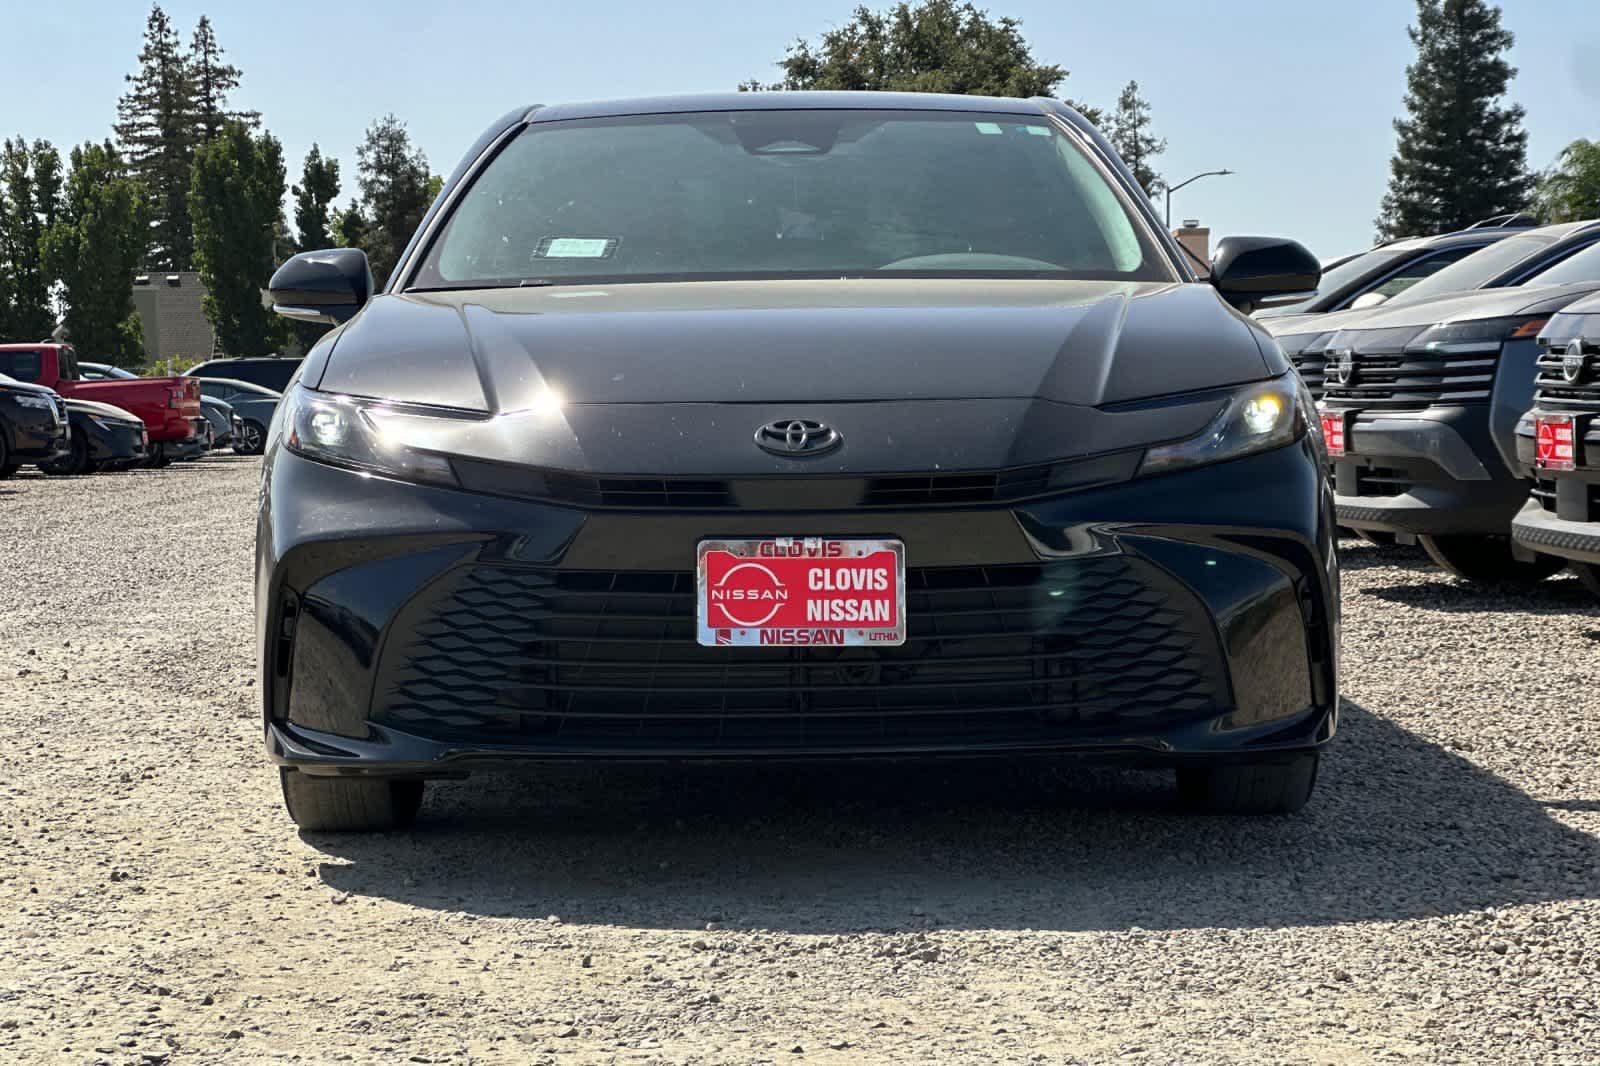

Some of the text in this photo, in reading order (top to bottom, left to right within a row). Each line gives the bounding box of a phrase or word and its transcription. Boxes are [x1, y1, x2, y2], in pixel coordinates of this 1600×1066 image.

[760, 541, 841, 557] CLOVIS
[808, 568, 888, 590] CLOVIS
[711, 589, 788, 600] NISSAN
[807, 600, 890, 621] NISSAN
[759, 629, 844, 645] NISSAN
[869, 632, 899, 641] LITHIA
